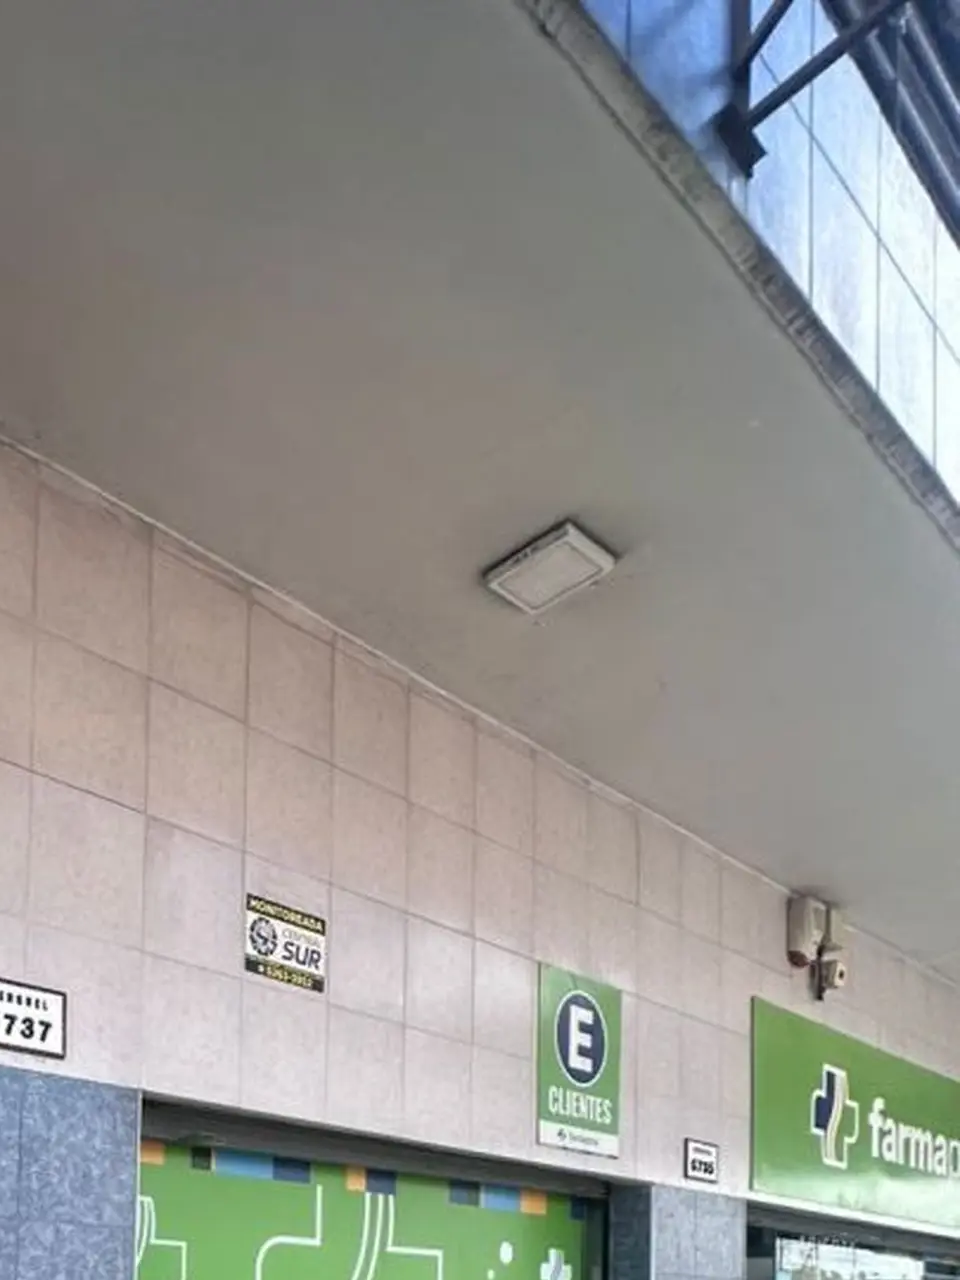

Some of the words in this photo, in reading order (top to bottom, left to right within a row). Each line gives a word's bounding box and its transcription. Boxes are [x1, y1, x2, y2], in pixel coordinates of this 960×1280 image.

[282, 941, 321, 969] SUR
[568, 1004, 594, 1073] E
[548, 1085, 613, 1124] CLIENTES
